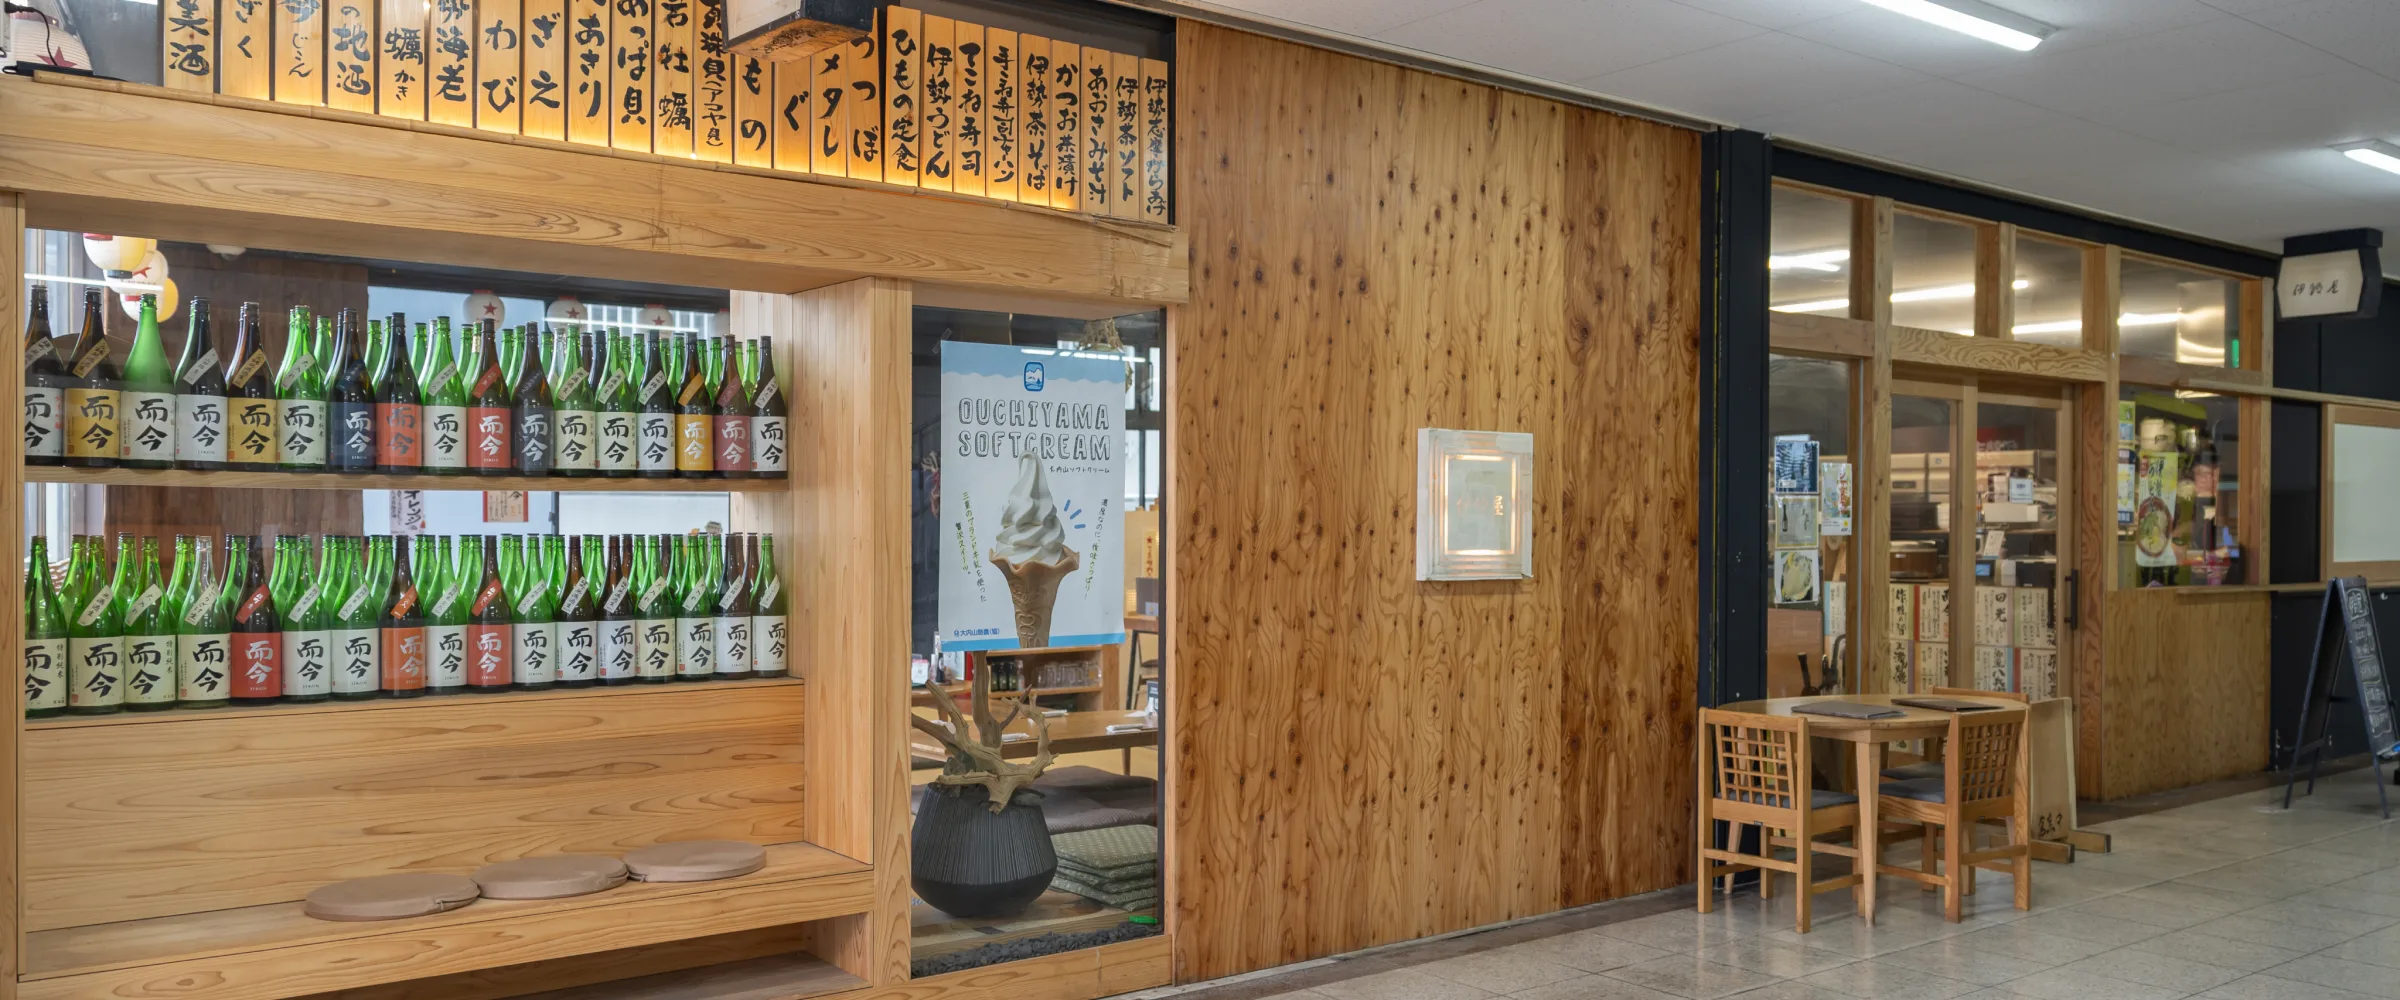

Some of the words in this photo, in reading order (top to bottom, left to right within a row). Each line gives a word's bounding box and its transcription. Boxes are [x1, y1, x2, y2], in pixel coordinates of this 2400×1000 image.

[332, 6, 371, 95] の地酒
[482, 20, 517, 113] わび
[529, 12, 561, 109] ざえ
[784, 91, 809, 131] ぐ
[891, 29, 919, 172] ひもの定食
[926, 43, 953, 179] 伊勢うどん
[959, 42, 981, 176] てこね寿司
[1026, 53, 1049, 190] 伊勢茶そば
[1056, 63, 1079, 197] かつお茶漬け
[1088, 64, 1108, 204] あおさみそ汁
[1116, 75, 1139, 201] 伊勢茶ソフト
[81, 396, 114, 449] 而今
[135, 398, 168, 451] 而今
[192, 404, 220, 447] 而今
[240, 404, 271, 455] 而今
[284, 405, 314, 456] 而今
[346, 411, 371, 453] 而今
[386, 406, 415, 456] 而今
[433, 413, 458, 454] 而今
[479, 415, 504, 455] 而今
[958, 397, 1109, 430] OUCHIYAMA
[521, 414, 548, 461] 而今
[560, 415, 587, 462] 而今
[603, 417, 629, 463] 而今
[642, 418, 668, 463] 而今
[684, 421, 706, 459] 而今
[722, 420, 745, 464] 而今
[761, 421, 783, 464] 而今
[958, 430, 1110, 460] SOFTCREAM
[245, 640, 273, 684] 而今
[297, 639, 324, 681] 而今
[345, 636, 372, 678] 而今
[400, 634, 424, 677] 而今
[439, 632, 463, 673] 而今
[476, 632, 502, 673] 而今
[523, 629, 547, 669] 而今
[567, 627, 592, 674] 而今
[611, 624, 633, 671] 而今
[644, 624, 669, 670] 而今
[689, 622, 712, 668] 而今
[727, 624, 748, 661] 而今
[768, 622, 786, 659] 而今
[84, 643, 118, 698] 而今
[129, 642, 161, 695] 而今
[193, 640, 224, 692] 而今
